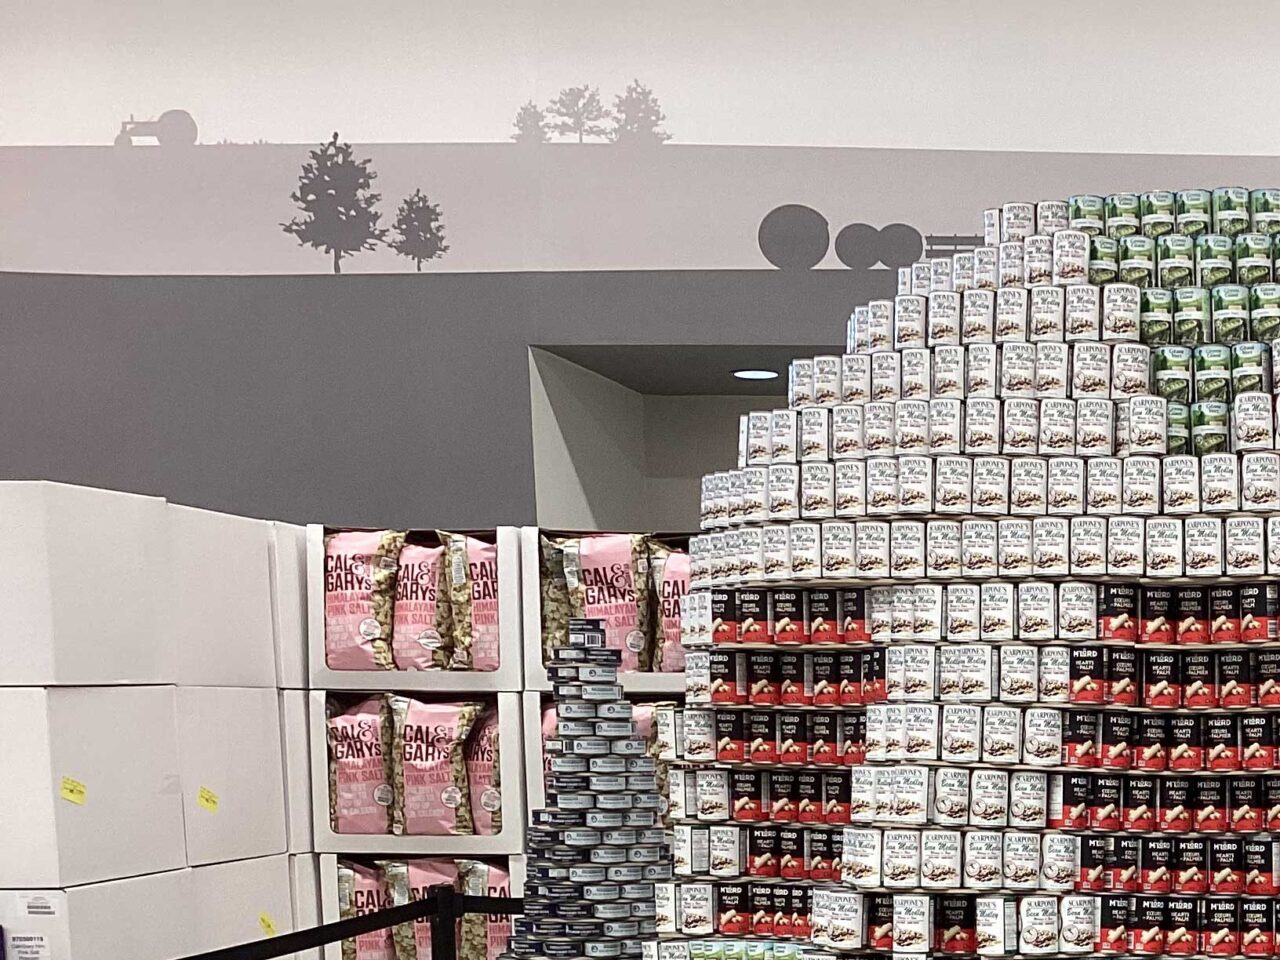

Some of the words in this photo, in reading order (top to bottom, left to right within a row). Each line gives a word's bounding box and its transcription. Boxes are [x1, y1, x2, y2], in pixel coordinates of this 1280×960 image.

[327, 603, 347, 615] PINK
[348, 602, 371, 615] SALT
[405, 773, 426, 785] PINK
[430, 773, 450, 784] SALT
